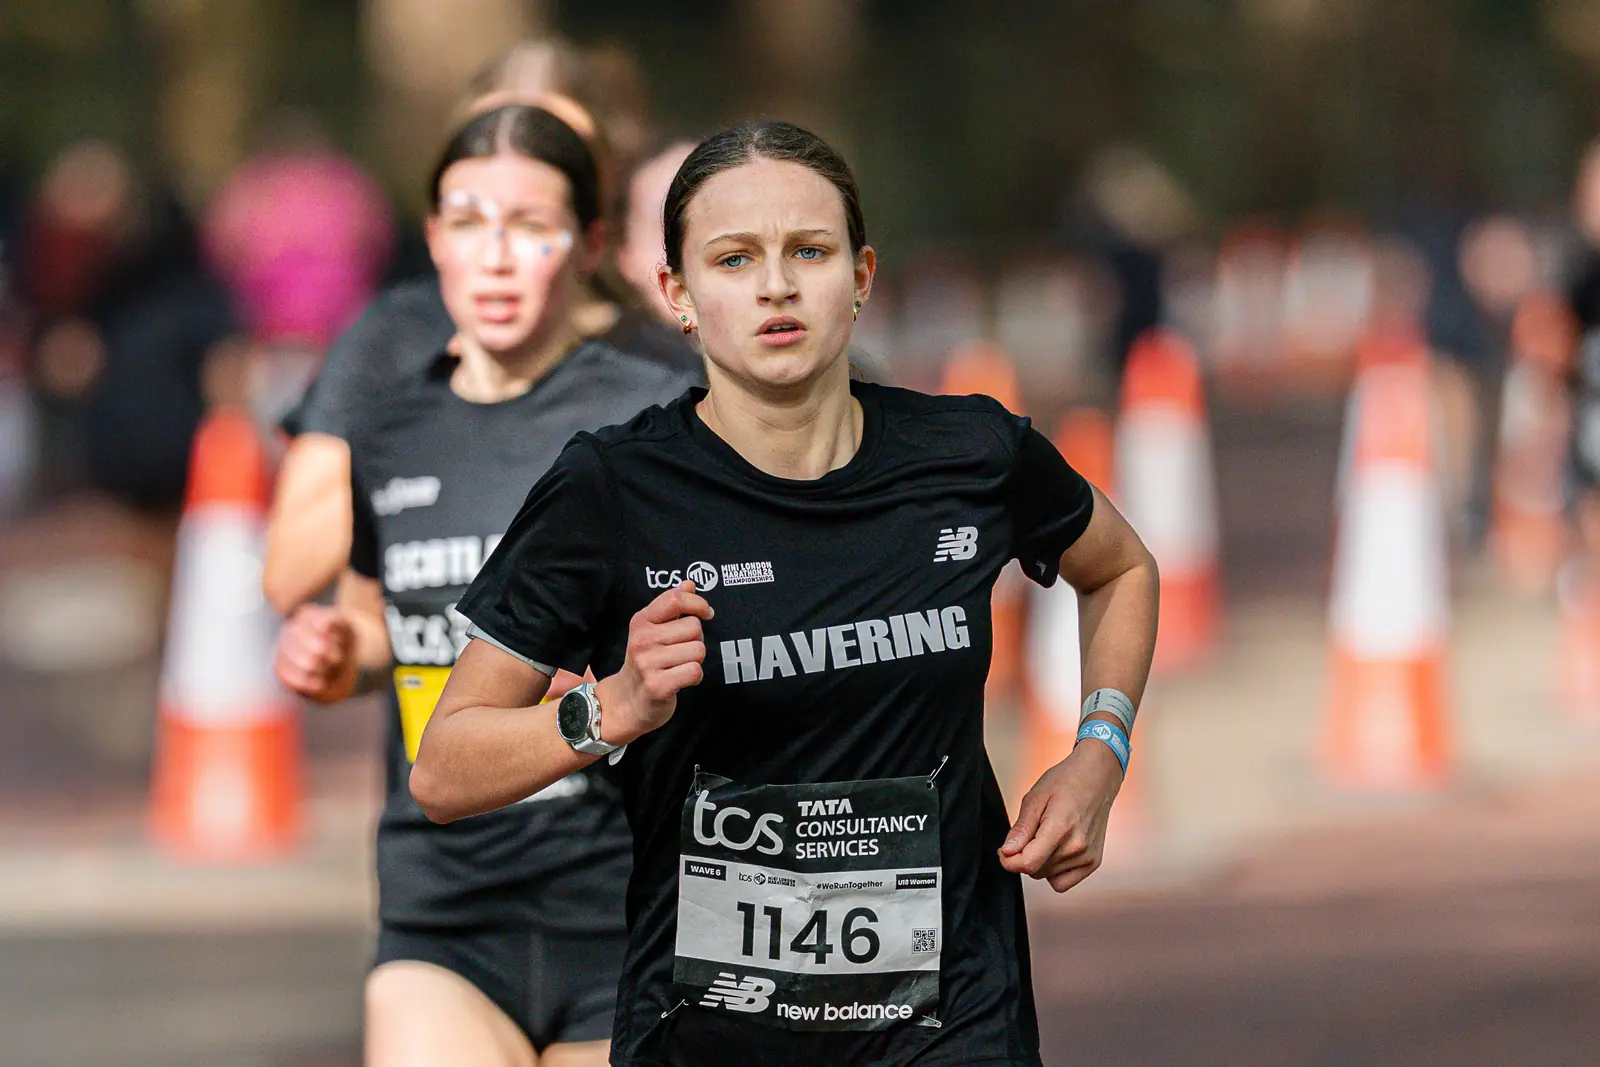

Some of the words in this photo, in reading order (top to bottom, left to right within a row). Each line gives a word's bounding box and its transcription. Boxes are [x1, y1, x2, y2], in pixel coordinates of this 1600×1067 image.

[385, 533, 506, 592] SCOTL
[721, 563, 739, 572] MINI
[740, 561, 772, 571] LONDON
[646, 566, 682, 588] tcs
[722, 569, 762, 579] MARATHON
[724, 575, 774, 585] CHAMPIONSHIPS
[720, 605, 970, 684] HAVERING
[797, 798, 853, 816] TATA
[693, 789, 784, 855] tcs
[795, 814, 928, 838] CONSULTANCY
[795, 839, 880, 859] SERVICES
[690, 865, 715, 875] WAVE
[738, 872, 753, 883] tcs
[816, 880, 884, 890] #WeRunTogether
[737, 901, 881, 965] 1146
[777, 1002, 820, 1021] new
[824, 1002, 913, 1021] balance
